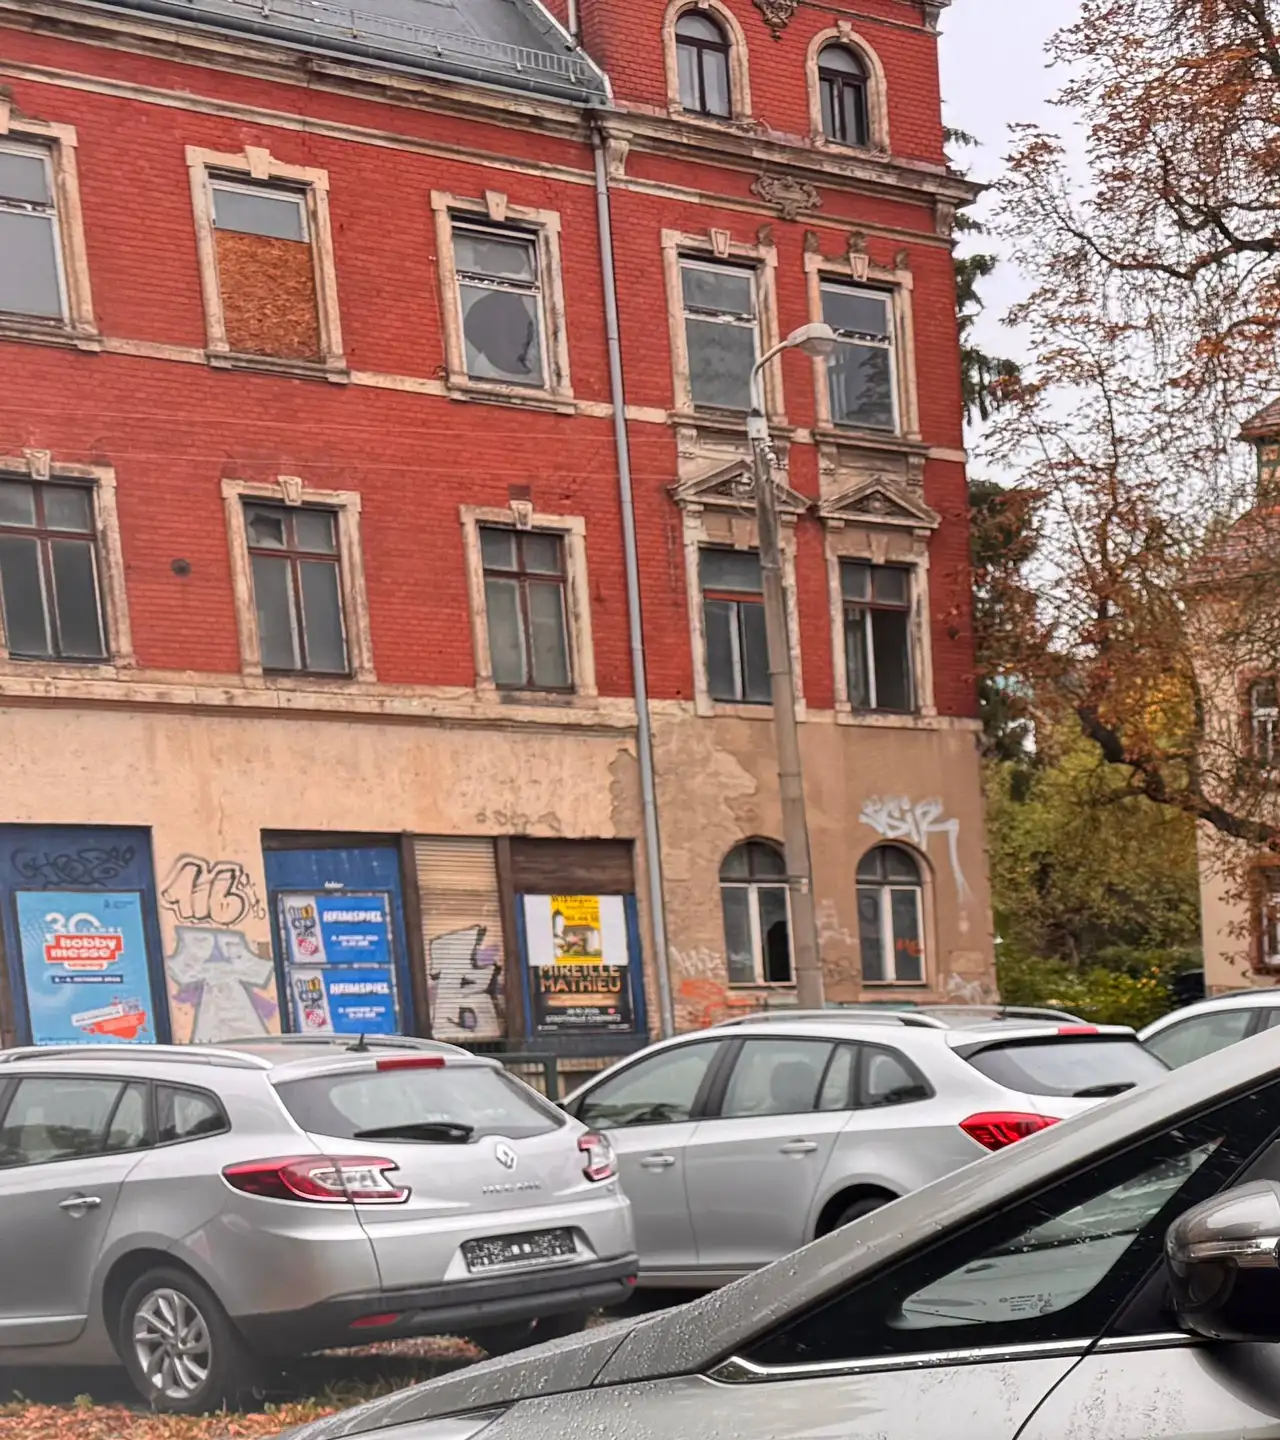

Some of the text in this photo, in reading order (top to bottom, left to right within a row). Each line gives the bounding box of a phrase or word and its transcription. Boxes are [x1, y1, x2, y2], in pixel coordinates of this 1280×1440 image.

[60, 936, 117, 950] hobby
[50, 947, 111, 958] messe
[539, 965, 620, 977] MIREILLE
[540, 978, 622, 993] MATHIEU
